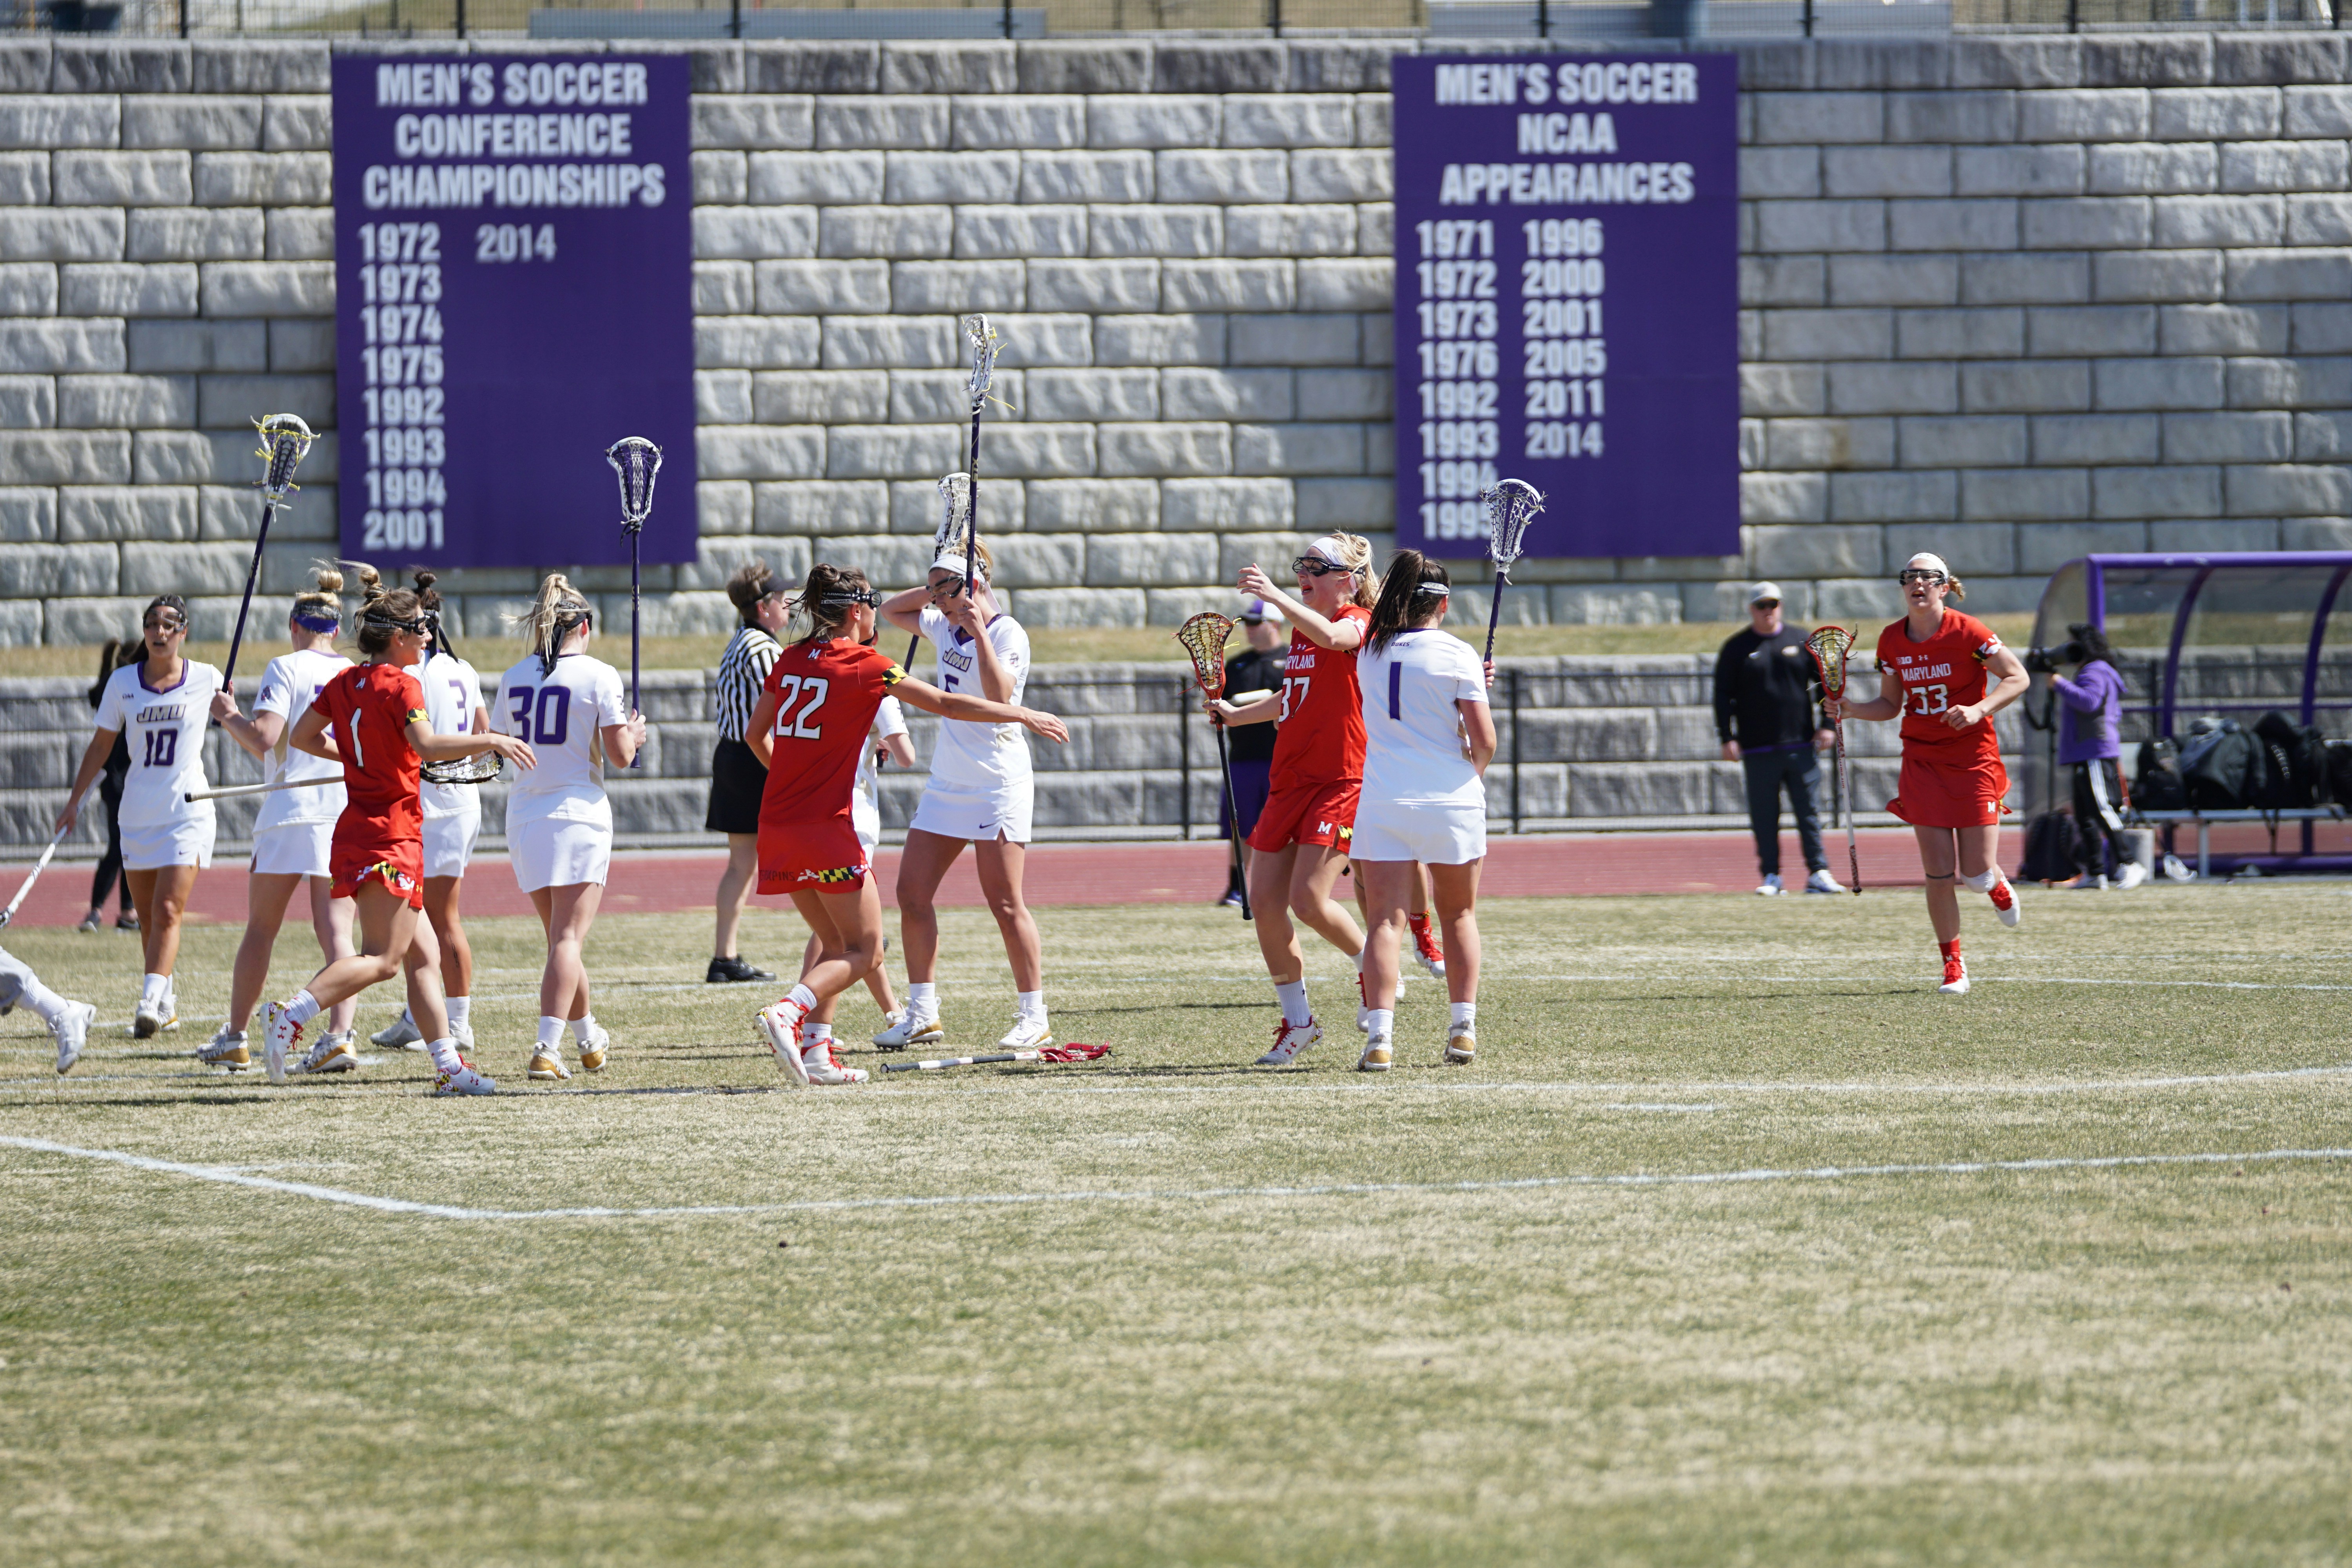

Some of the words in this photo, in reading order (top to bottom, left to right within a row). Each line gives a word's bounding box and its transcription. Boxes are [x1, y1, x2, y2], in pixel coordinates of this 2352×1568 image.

[377, 63, 494, 106] MEN'S
[504, 63, 648, 105] SOCCER
[1436, 63, 1550, 105] MEN'S
[1557, 62, 1697, 104] SOCCER
[396, 114, 632, 156] CONFERENCE
[1518, 113, 1617, 154] NCAA
[364, 164, 665, 208] CHAMPIONSHIPS
[1440, 162, 1694, 205] APPEARANCES
[360, 223, 441, 262] 1972
[477, 225, 556, 262] 2014
[1416, 220, 1494, 258] 1971
[1523, 218, 1603, 257] 1996
[361, 264, 441, 303] 1973
[1417, 260, 1497, 298] 1972
[1522, 258, 1604, 297] 2000
[362, 305, 443, 344] 1974
[1417, 301, 1498, 338] 1973
[1523, 299, 1602, 337] 2001
[363, 346, 444, 385] 1975
[1418, 341, 1498, 378] 1976
[1524, 339, 1606, 377] 2005
[364, 387, 445, 426] 1992
[1419, 381, 1499, 418] 1992
[1525, 379, 1604, 417] 2011
[365, 428, 445, 466] 1993
[1419, 421, 1499, 459] 1993
[1526, 421, 1603, 458] 2014
[366, 468, 446, 508] 1994
[1419, 461, 1499, 498] 1994
[364, 509, 444, 549] 2001
[808, 648, 822, 659] M
[1901, 663, 1951, 681] MARYLAND
[448, 679, 468, 732] 3
[776, 674, 829, 740] 22
[1278, 675, 1310, 723] 37
[1388, 660, 1403, 721] 1
[1910, 683, 1948, 715] 33
[136, 704, 187, 723] JMU
[508, 685, 571, 744] 30
[144, 729, 178, 768] 10
[350, 707, 364, 768] 1
[1987, 801, 1996, 813] M
[1317, 821, 1333, 835] M
